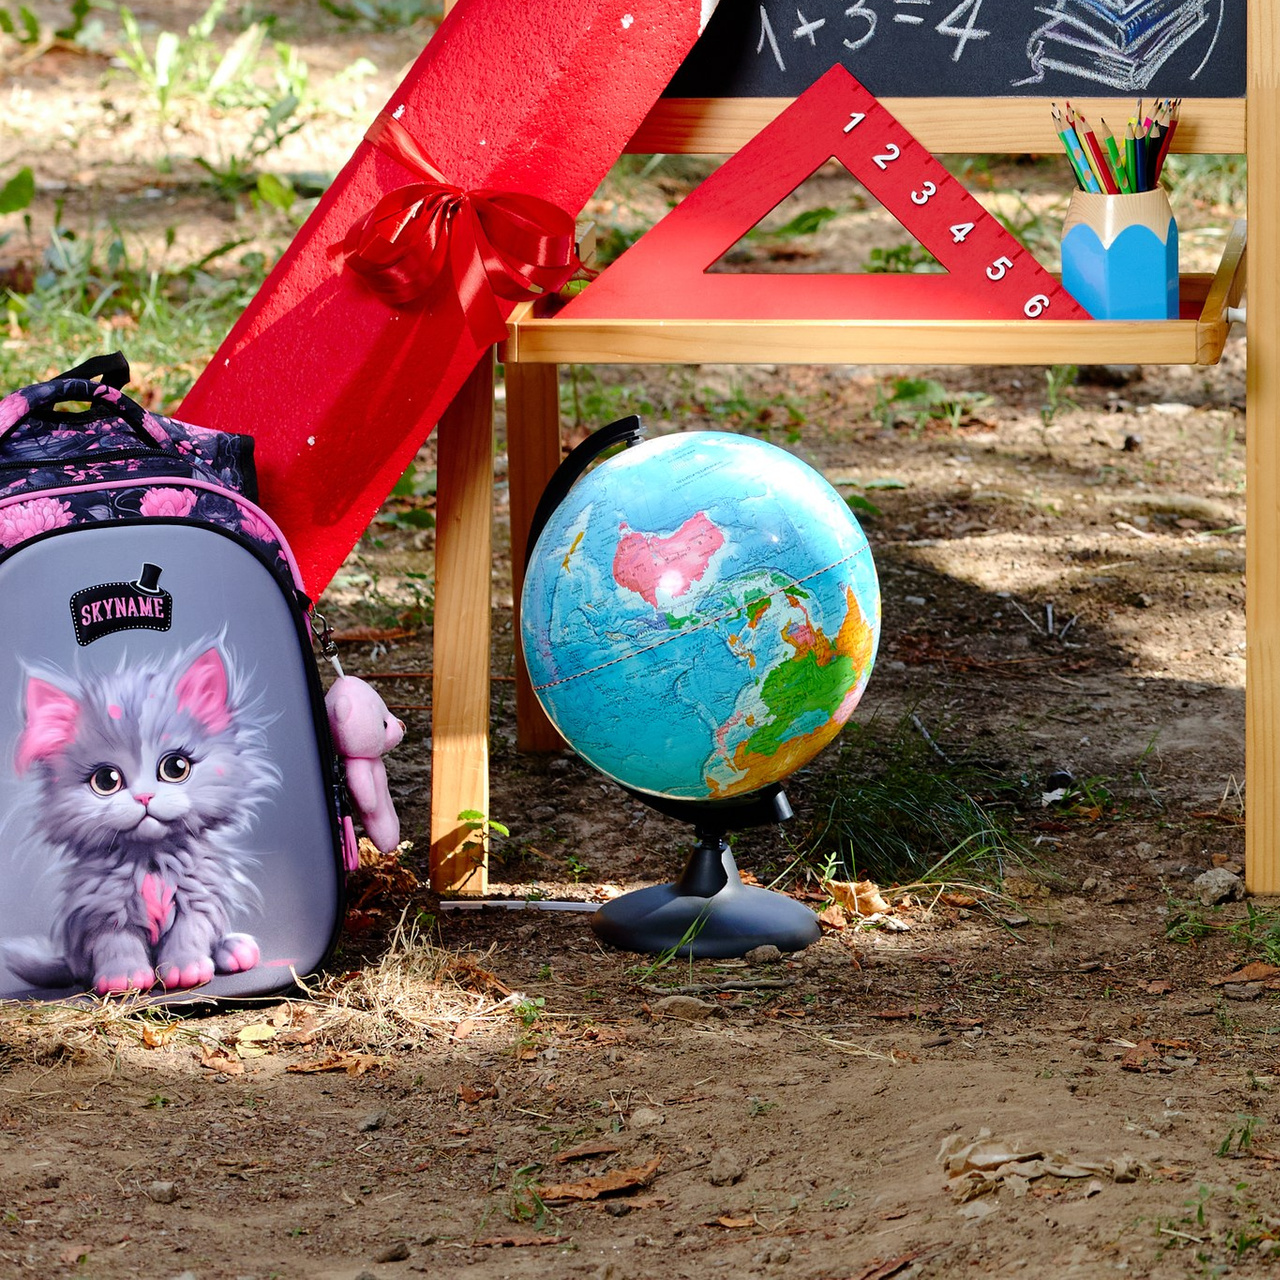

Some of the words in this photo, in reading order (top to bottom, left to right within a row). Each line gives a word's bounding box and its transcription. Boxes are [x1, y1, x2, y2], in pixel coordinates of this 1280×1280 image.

[842, 111, 866, 134] 1
[872, 143, 900, 170] 2
[909, 180, 937, 205] 3
[948, 219, 976, 244] 4
[984, 255, 1014, 281] 5
[1022, 294, 1050, 318] 6
[81, 596, 165, 626] SKYNAME
